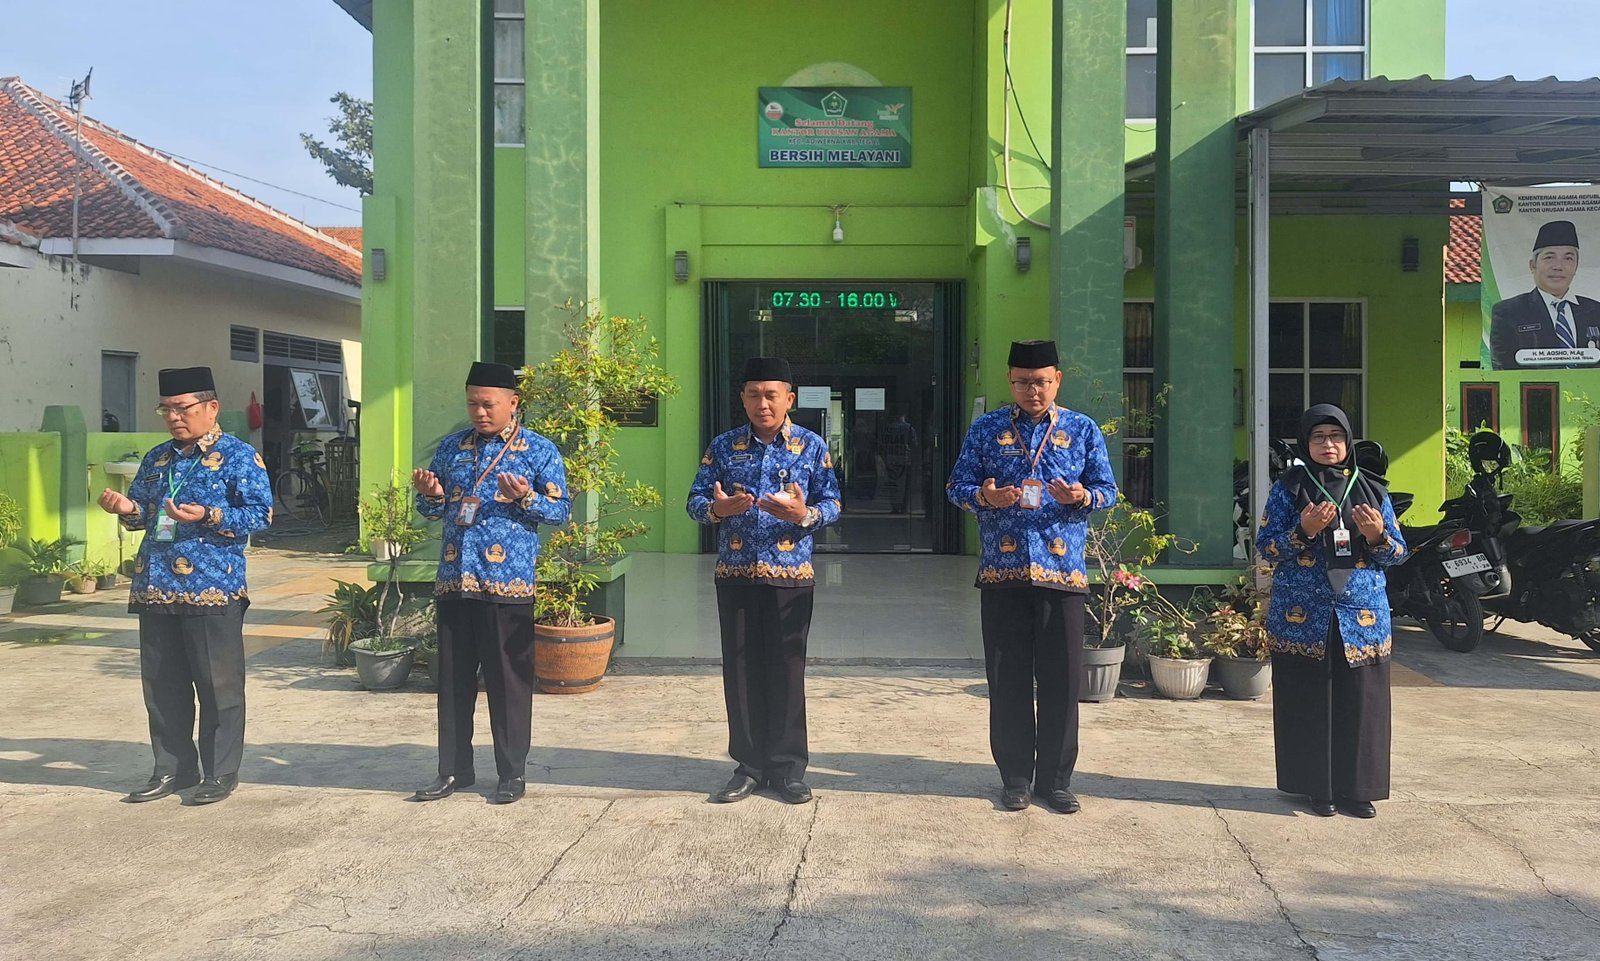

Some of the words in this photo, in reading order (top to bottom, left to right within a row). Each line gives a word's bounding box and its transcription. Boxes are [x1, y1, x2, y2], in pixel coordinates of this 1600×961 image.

[794, 118, 836, 128] Selamat
[838, 118, 874, 129] Datang
[771, 128, 814, 137] KANTOR
[816, 128, 856, 137] URUSAN
[859, 128, 897, 138] AGAMA
[769, 150, 823, 162] BERSIH
[828, 150, 900, 162] MELAYANI
[772, 292, 821, 308] 07.30
[838, 292, 884, 308] 16.00
[1454, 558, 1472, 567] 6934
